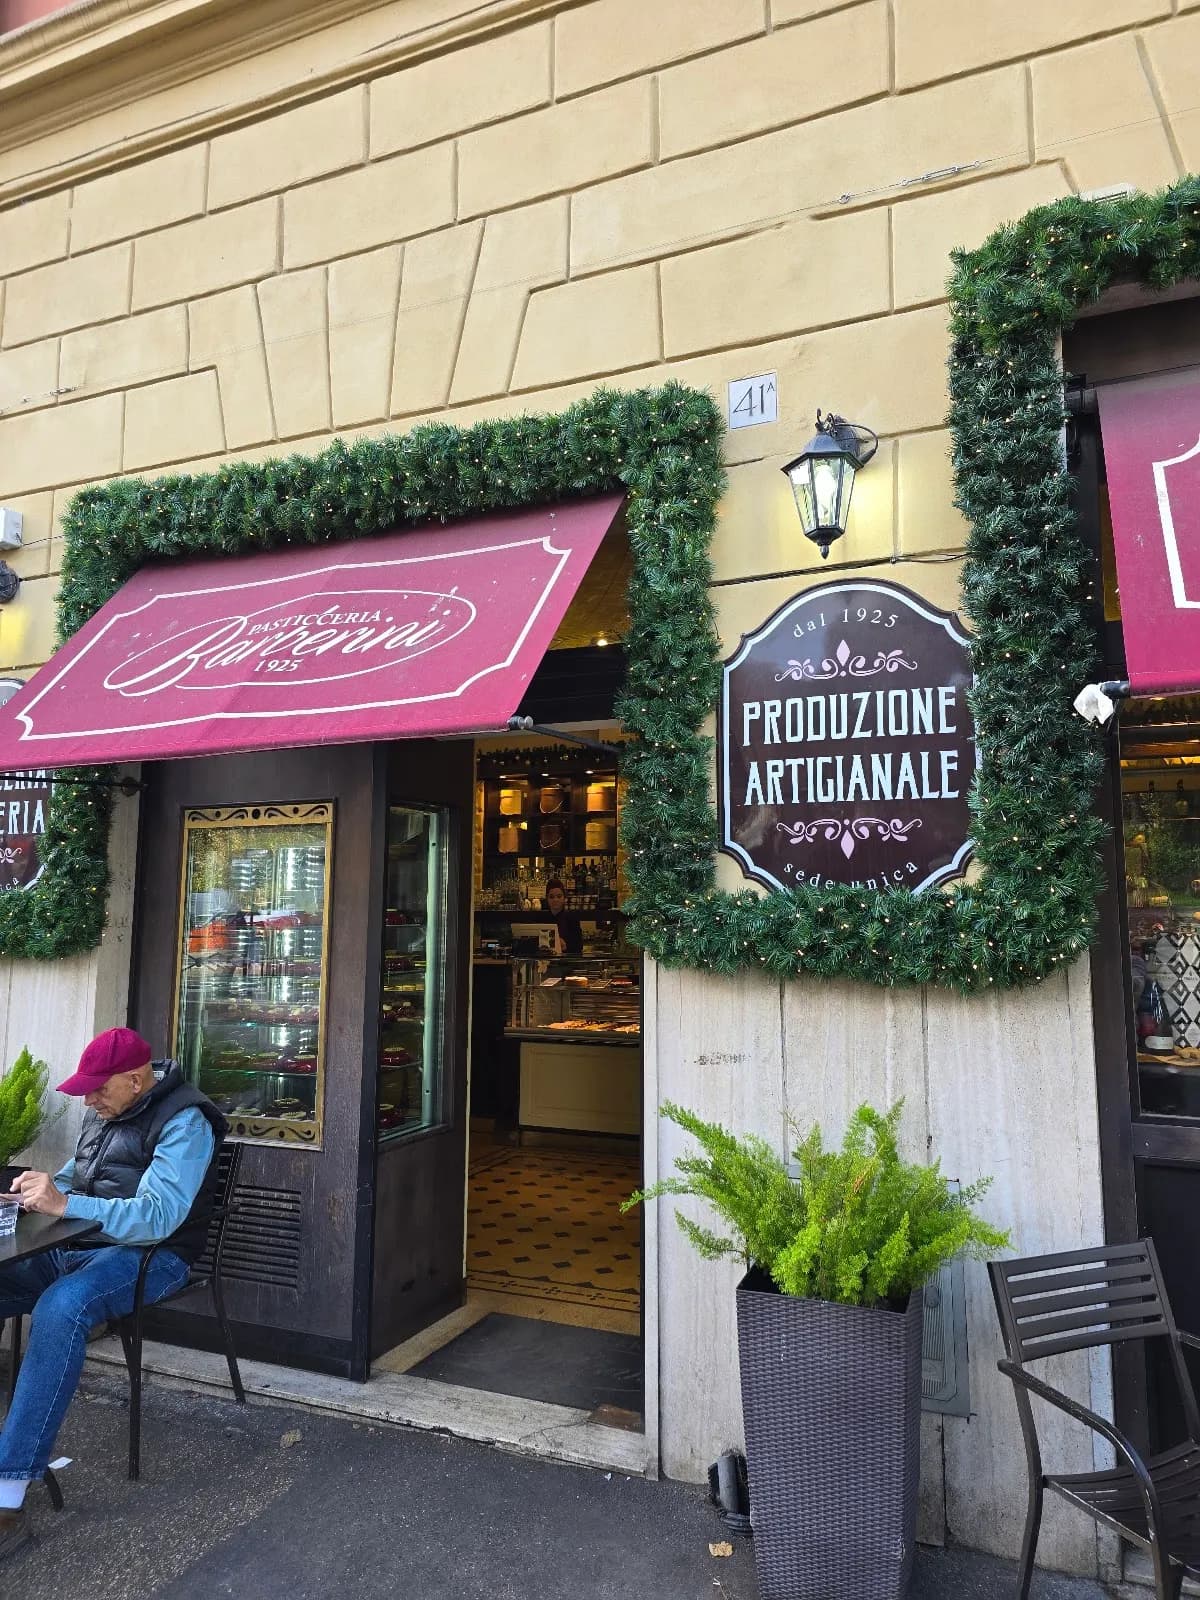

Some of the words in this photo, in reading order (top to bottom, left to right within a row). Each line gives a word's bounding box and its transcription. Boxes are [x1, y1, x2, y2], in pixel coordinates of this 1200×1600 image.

[248, 610, 381, 635] PASTICCERIA
[793, 612, 826, 638] dal
[842, 607, 899, 628] 1925
[254, 659, 304, 672] 1925
[742, 686, 957, 747] PRODUZIONE
[744, 750, 959, 806] ARTIGIANALE
[783, 863, 836, 890] sede
